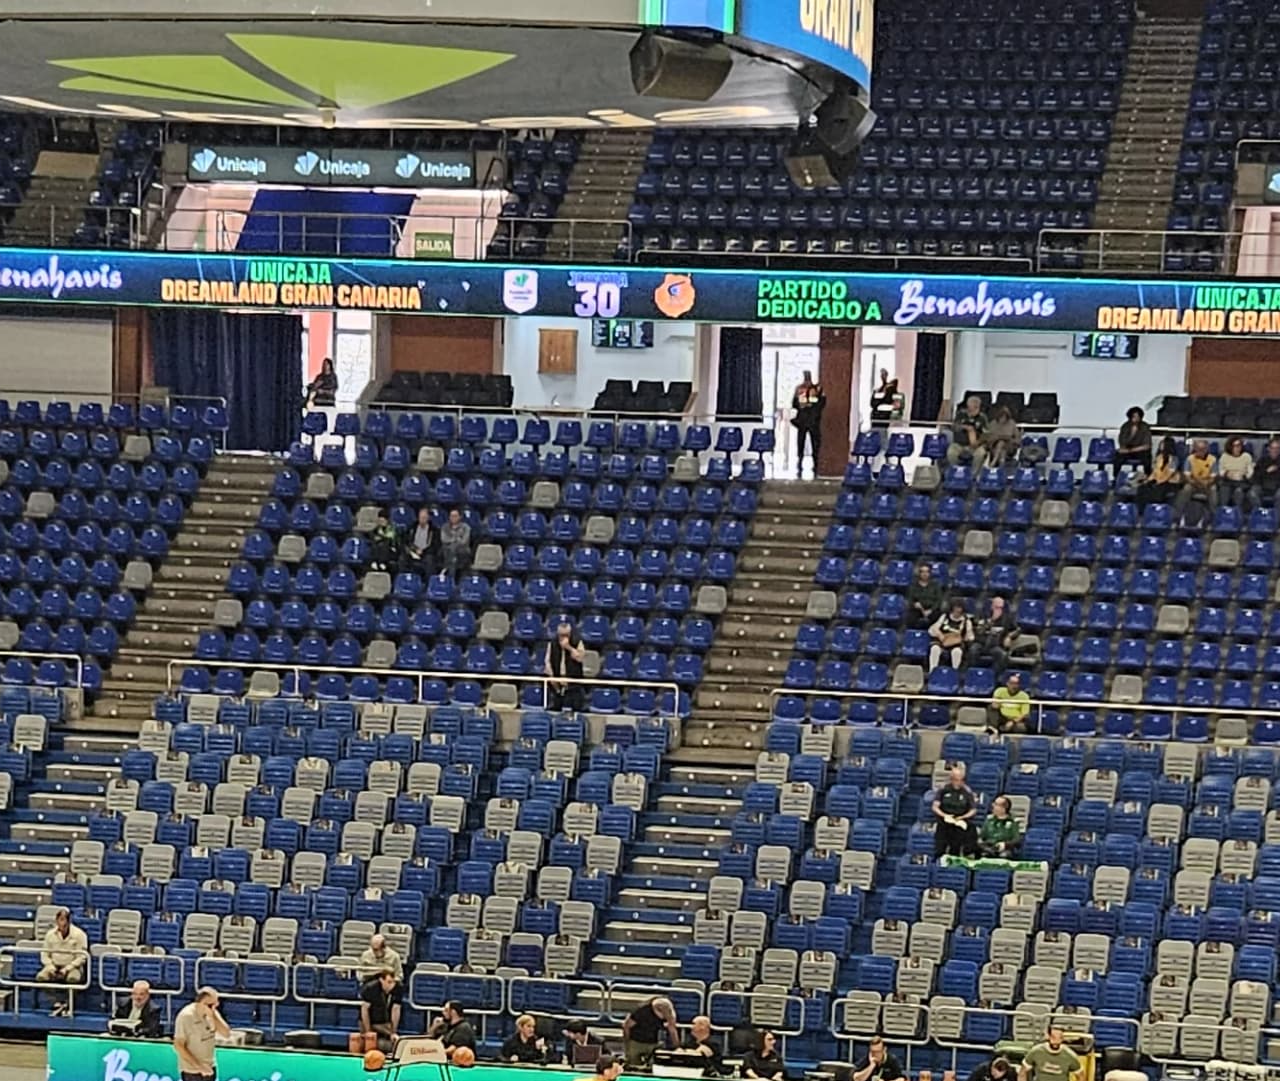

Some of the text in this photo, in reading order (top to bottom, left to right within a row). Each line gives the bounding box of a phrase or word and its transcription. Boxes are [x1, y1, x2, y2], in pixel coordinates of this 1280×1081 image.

[216, 156, 266, 175] Unicaja
[320, 158, 371, 178] Unicaja
[420, 162, 471, 181] Unicaja
[415, 240, 451, 252] SALIDA
[250, 261, 331, 283] UNICAJA
[161, 279, 420, 309] DREAMLAND GRAN CANARIA
[758, 280, 846, 299] PARTIDO
[575, 283, 619, 318] 30
[758, 300, 881, 320] DEDICADO A
[1097, 307, 1225, 331] DREAMLAND
